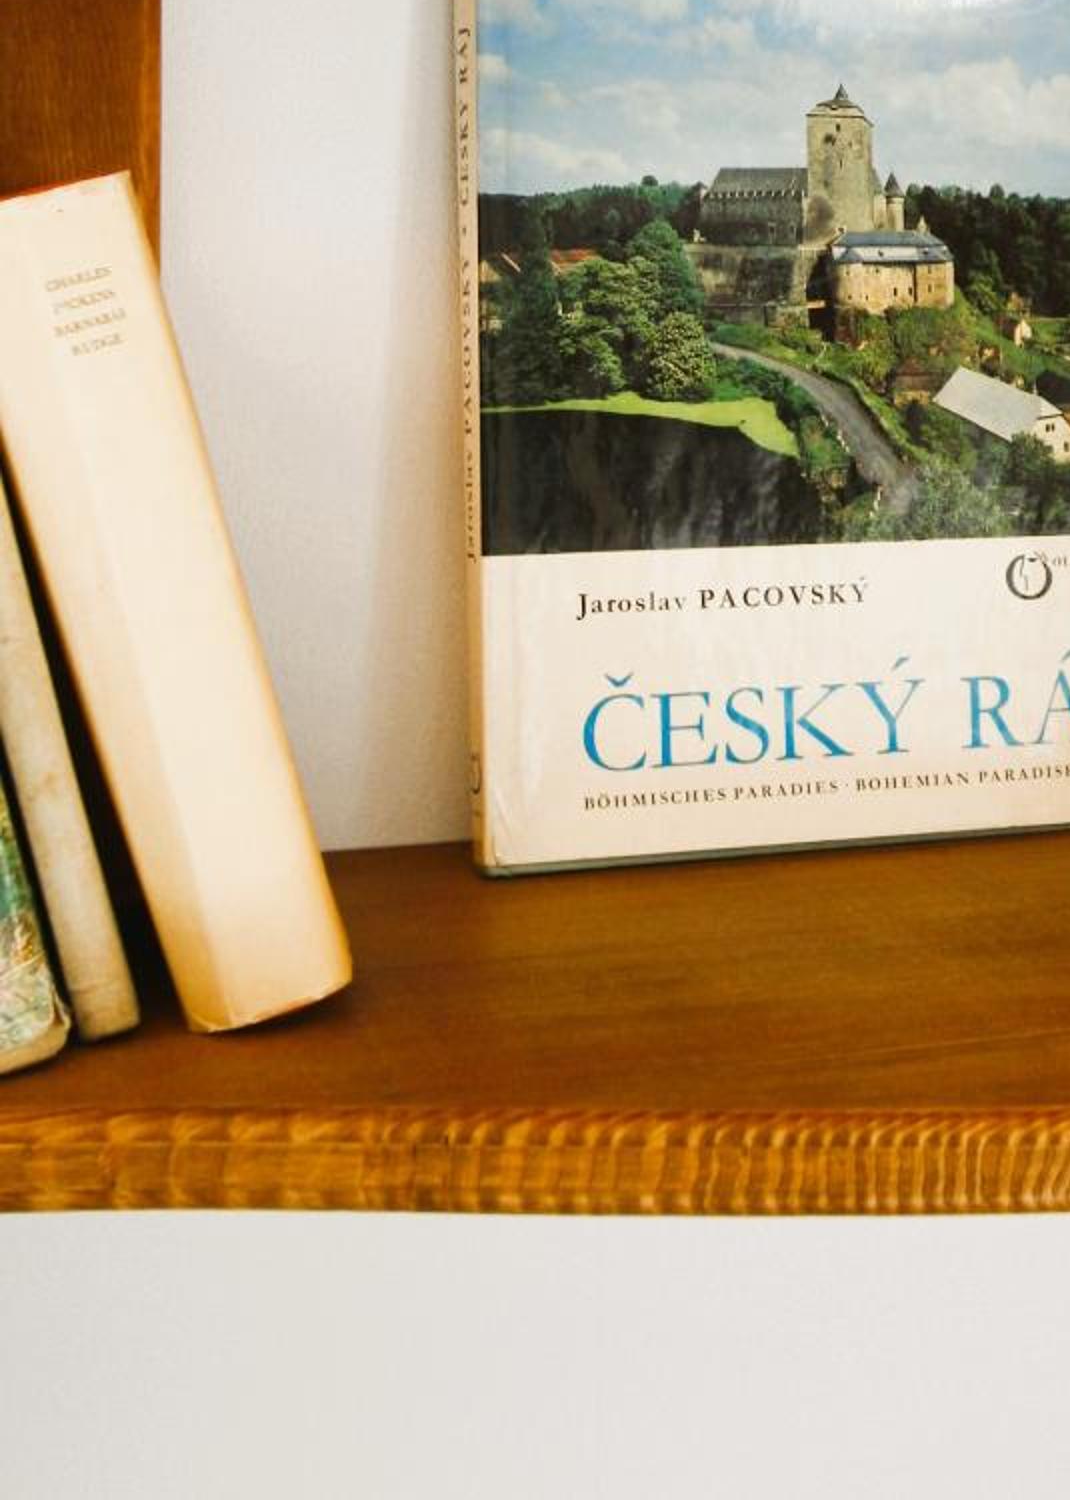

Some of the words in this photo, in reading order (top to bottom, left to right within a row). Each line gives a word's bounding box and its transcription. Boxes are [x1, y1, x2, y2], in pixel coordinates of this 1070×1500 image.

[575, 592, 686, 621] Jaroslav
[698, 576, 868, 610] PACOVSKÝ
[582, 656, 926, 772] ČESKÝ
[584, 788, 727, 811] BÖHMISCHES
[733, 779, 839, 800] PARADIES
[856, 771, 971, 793] BOHEMIAN
